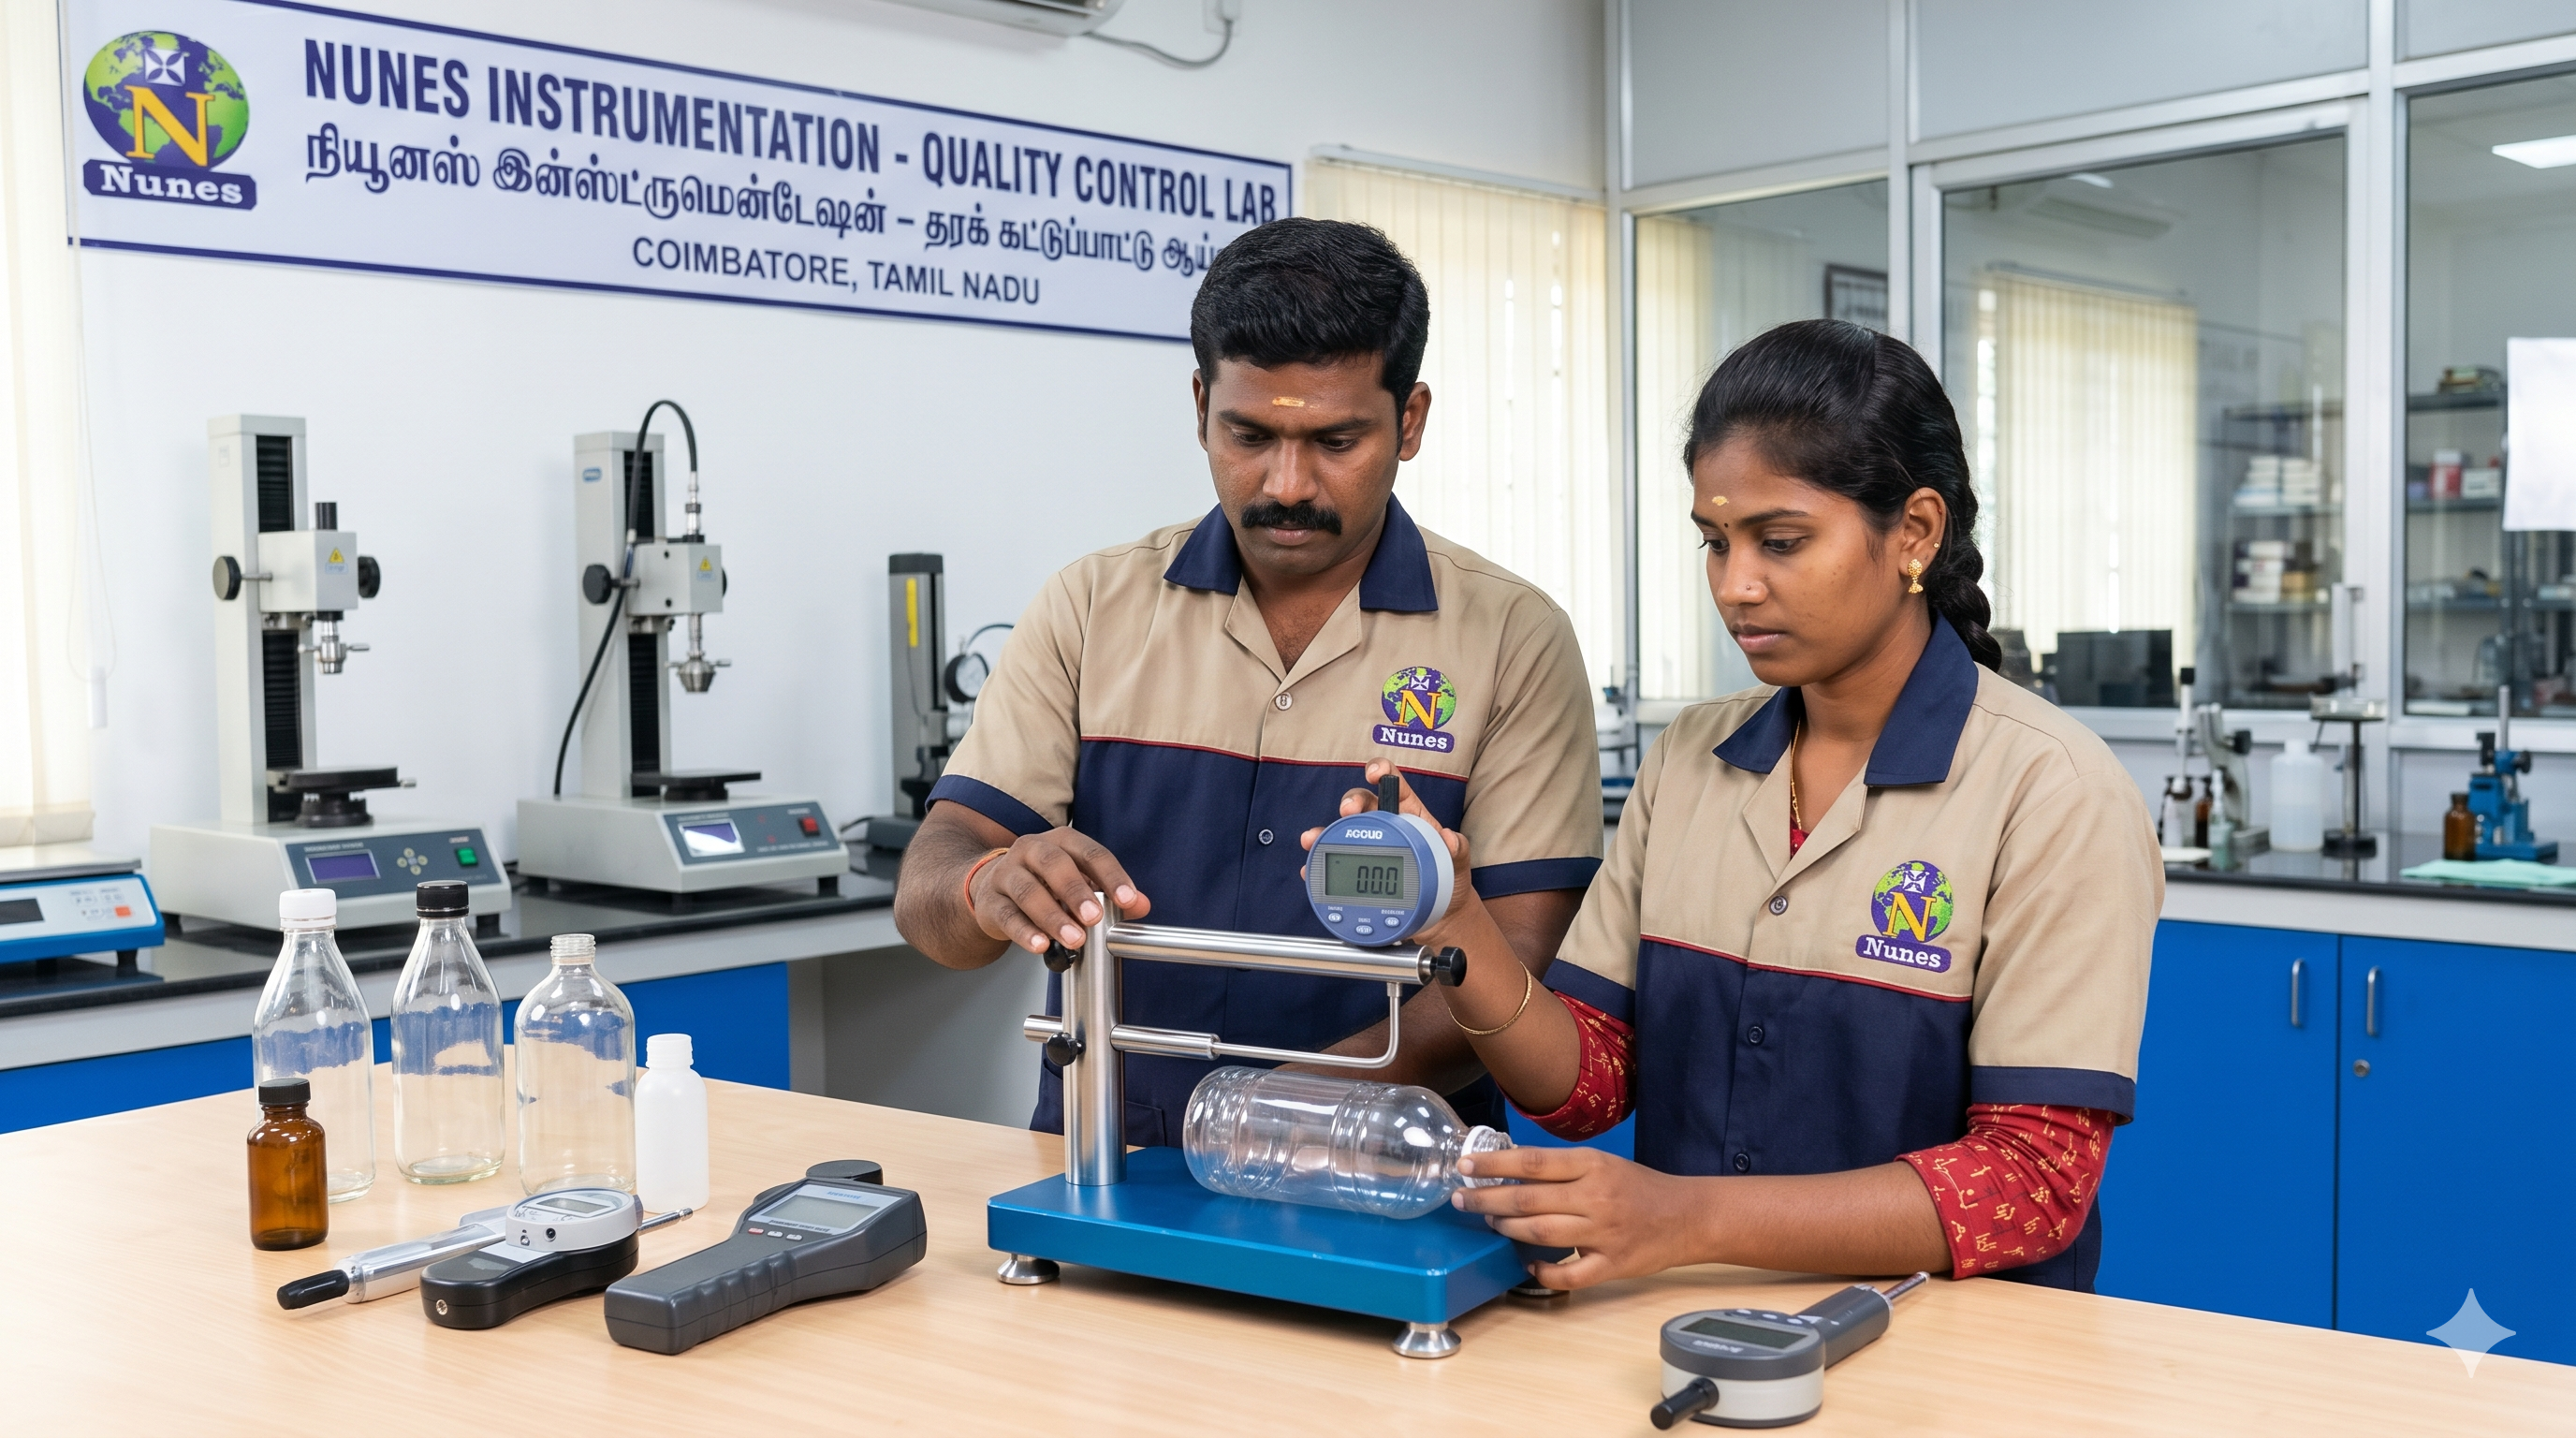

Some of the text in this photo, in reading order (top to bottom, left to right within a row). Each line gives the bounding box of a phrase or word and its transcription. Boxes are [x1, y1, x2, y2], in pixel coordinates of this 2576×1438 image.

[124, 84, 216, 167] N
[304, 38, 1276, 227] NUNES INSTRUMENTATION - QUALITY CONTROL LAB
[99, 164, 243, 204] Nunes
[305, 122, 480, 194] நியூனஸ்
[492, 147, 887, 240] இன்ஸ்ட்ருமென்டேஷன்
[924, 202, 990, 250] தரக்
[999, 216, 1155, 272] கட்டுப்பாட்டு
[1162, 231, 1222, 278] ஆய்
[633, 236, 1039, 305] COIMBATORE, TAMIL NADU
[1393, 689, 1442, 730] N
[1380, 726, 1448, 750] Nunes
[1882, 890, 1937, 943] N
[1863, 936, 1941, 968] Nunes
